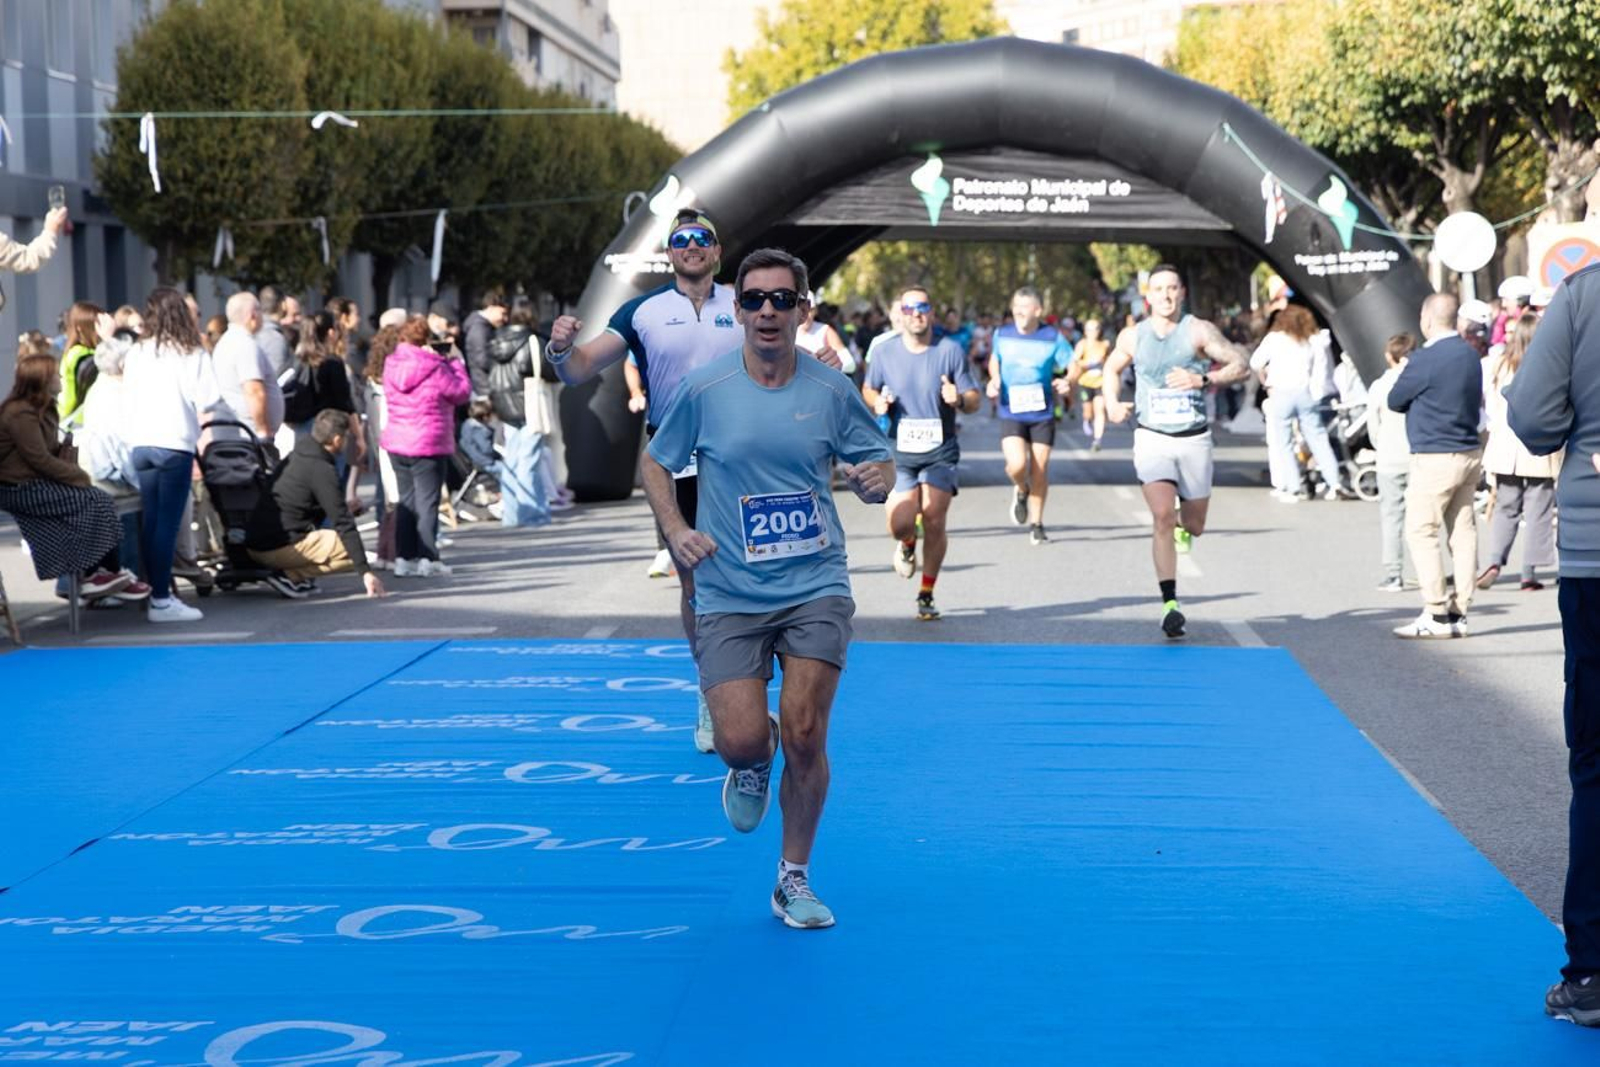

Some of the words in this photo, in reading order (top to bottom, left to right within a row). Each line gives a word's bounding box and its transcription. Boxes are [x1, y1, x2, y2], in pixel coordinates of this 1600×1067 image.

[954, 178, 1028, 194] Patronato
[1032, 179, 1106, 198] Municipal
[1109, 180, 1131, 196] de
[953, 195, 1024, 214] Deportes
[1027, 197, 1047, 212] de
[1050, 196, 1089, 212] Jaén
[906, 429, 934, 441] 429
[750, 504, 820, 537] 2004
[52, 924, 274, 935] MEDIA
[4, 1020, 216, 1034] JAÉN
